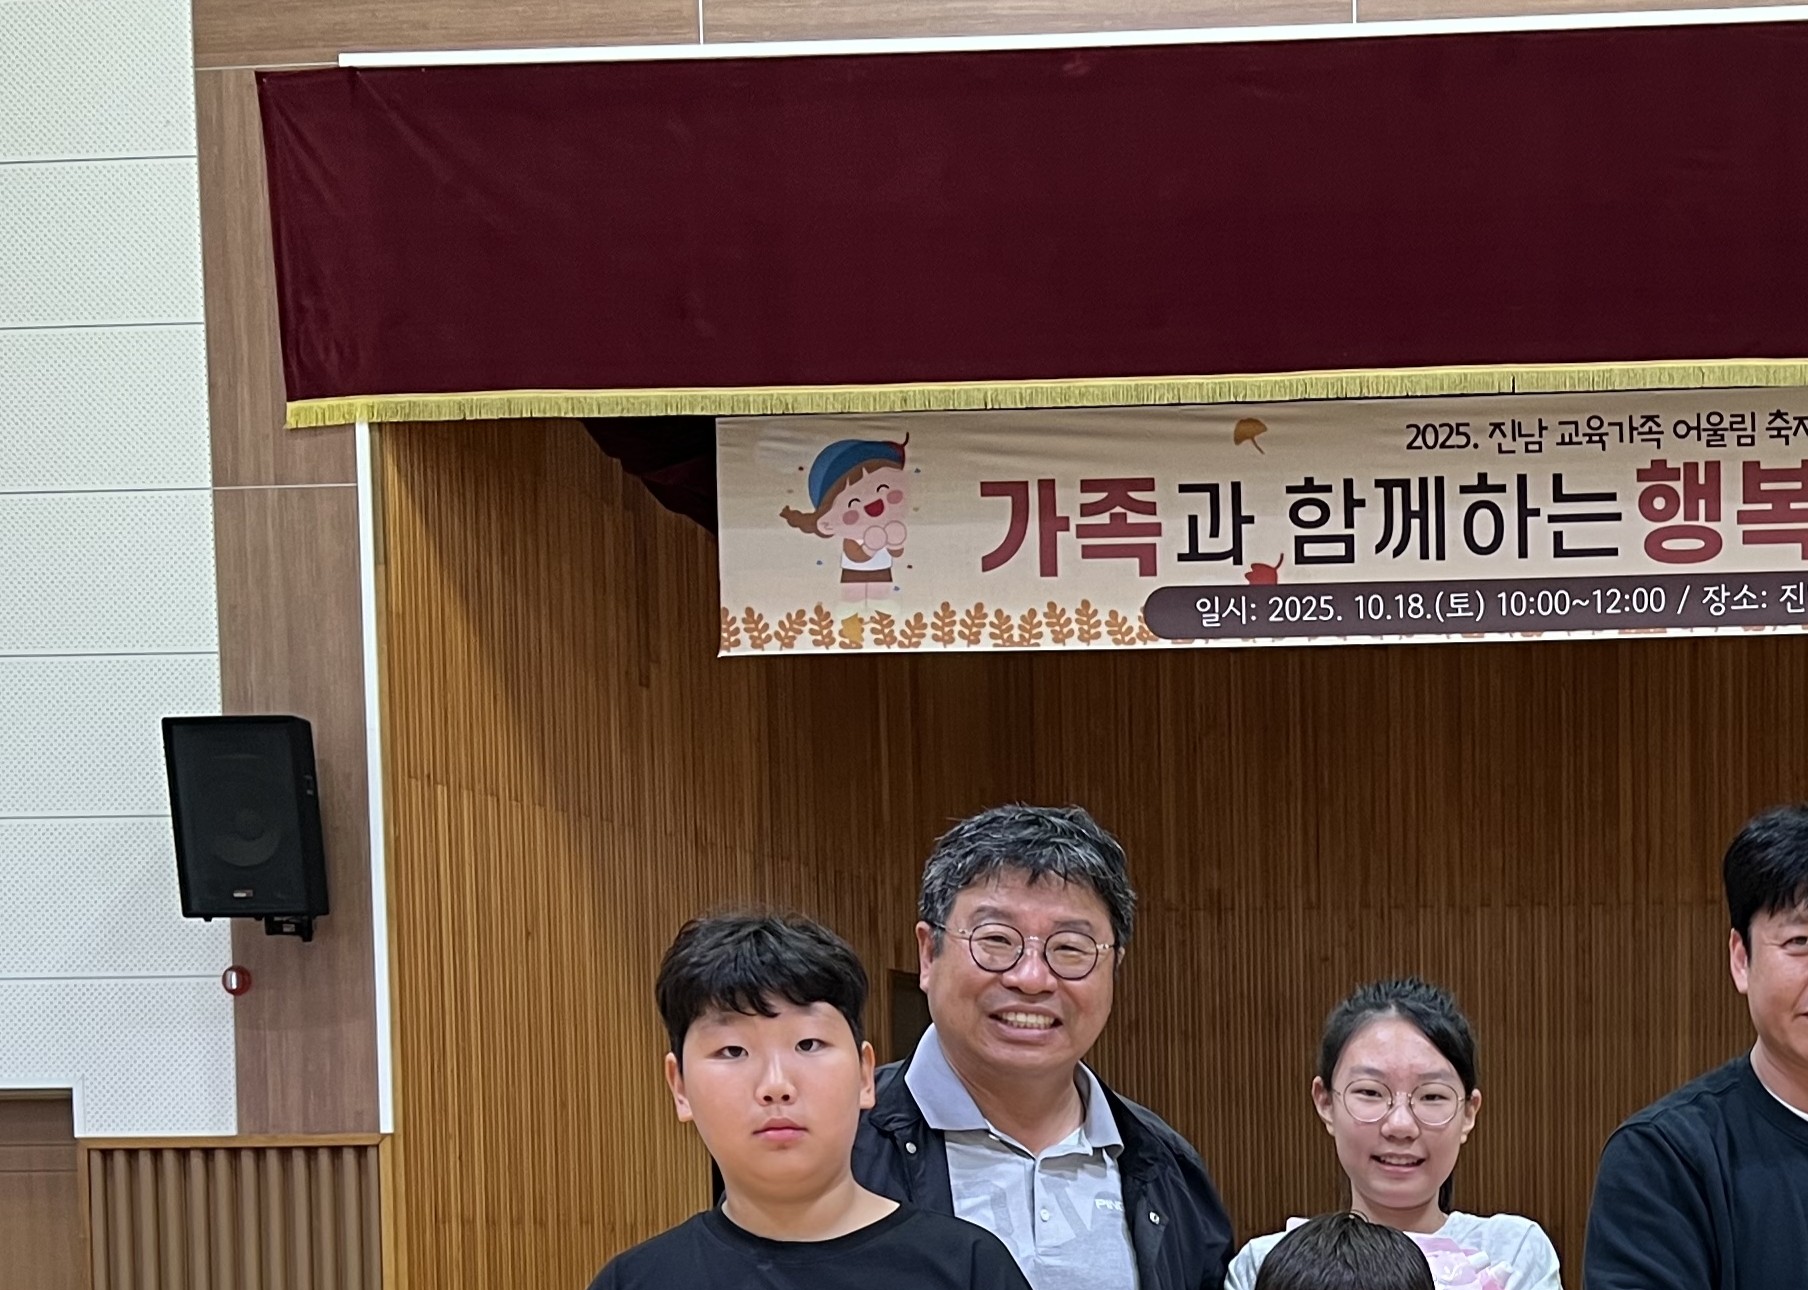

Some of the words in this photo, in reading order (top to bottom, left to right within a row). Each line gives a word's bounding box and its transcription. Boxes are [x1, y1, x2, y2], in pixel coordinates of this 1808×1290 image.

[1405, 423, 1479, 450] 2025.
[1488, 418, 1548, 454] 진남
[1556, 414, 1664, 451] 교육가족
[1672, 411, 1756, 448] 어울림
[979, 477, 1254, 578] 가족과
[1284, 472, 1622, 567] 함께하는
[1196, 597, 1256, 627] 일시:
[1268, 596, 1342, 622] 2025.
[1355, 592, 1485, 622] 10.18.(토)
[1498, 587, 1666, 616] 10:00~12:00
[1702, 584, 1768, 616] 장소:
